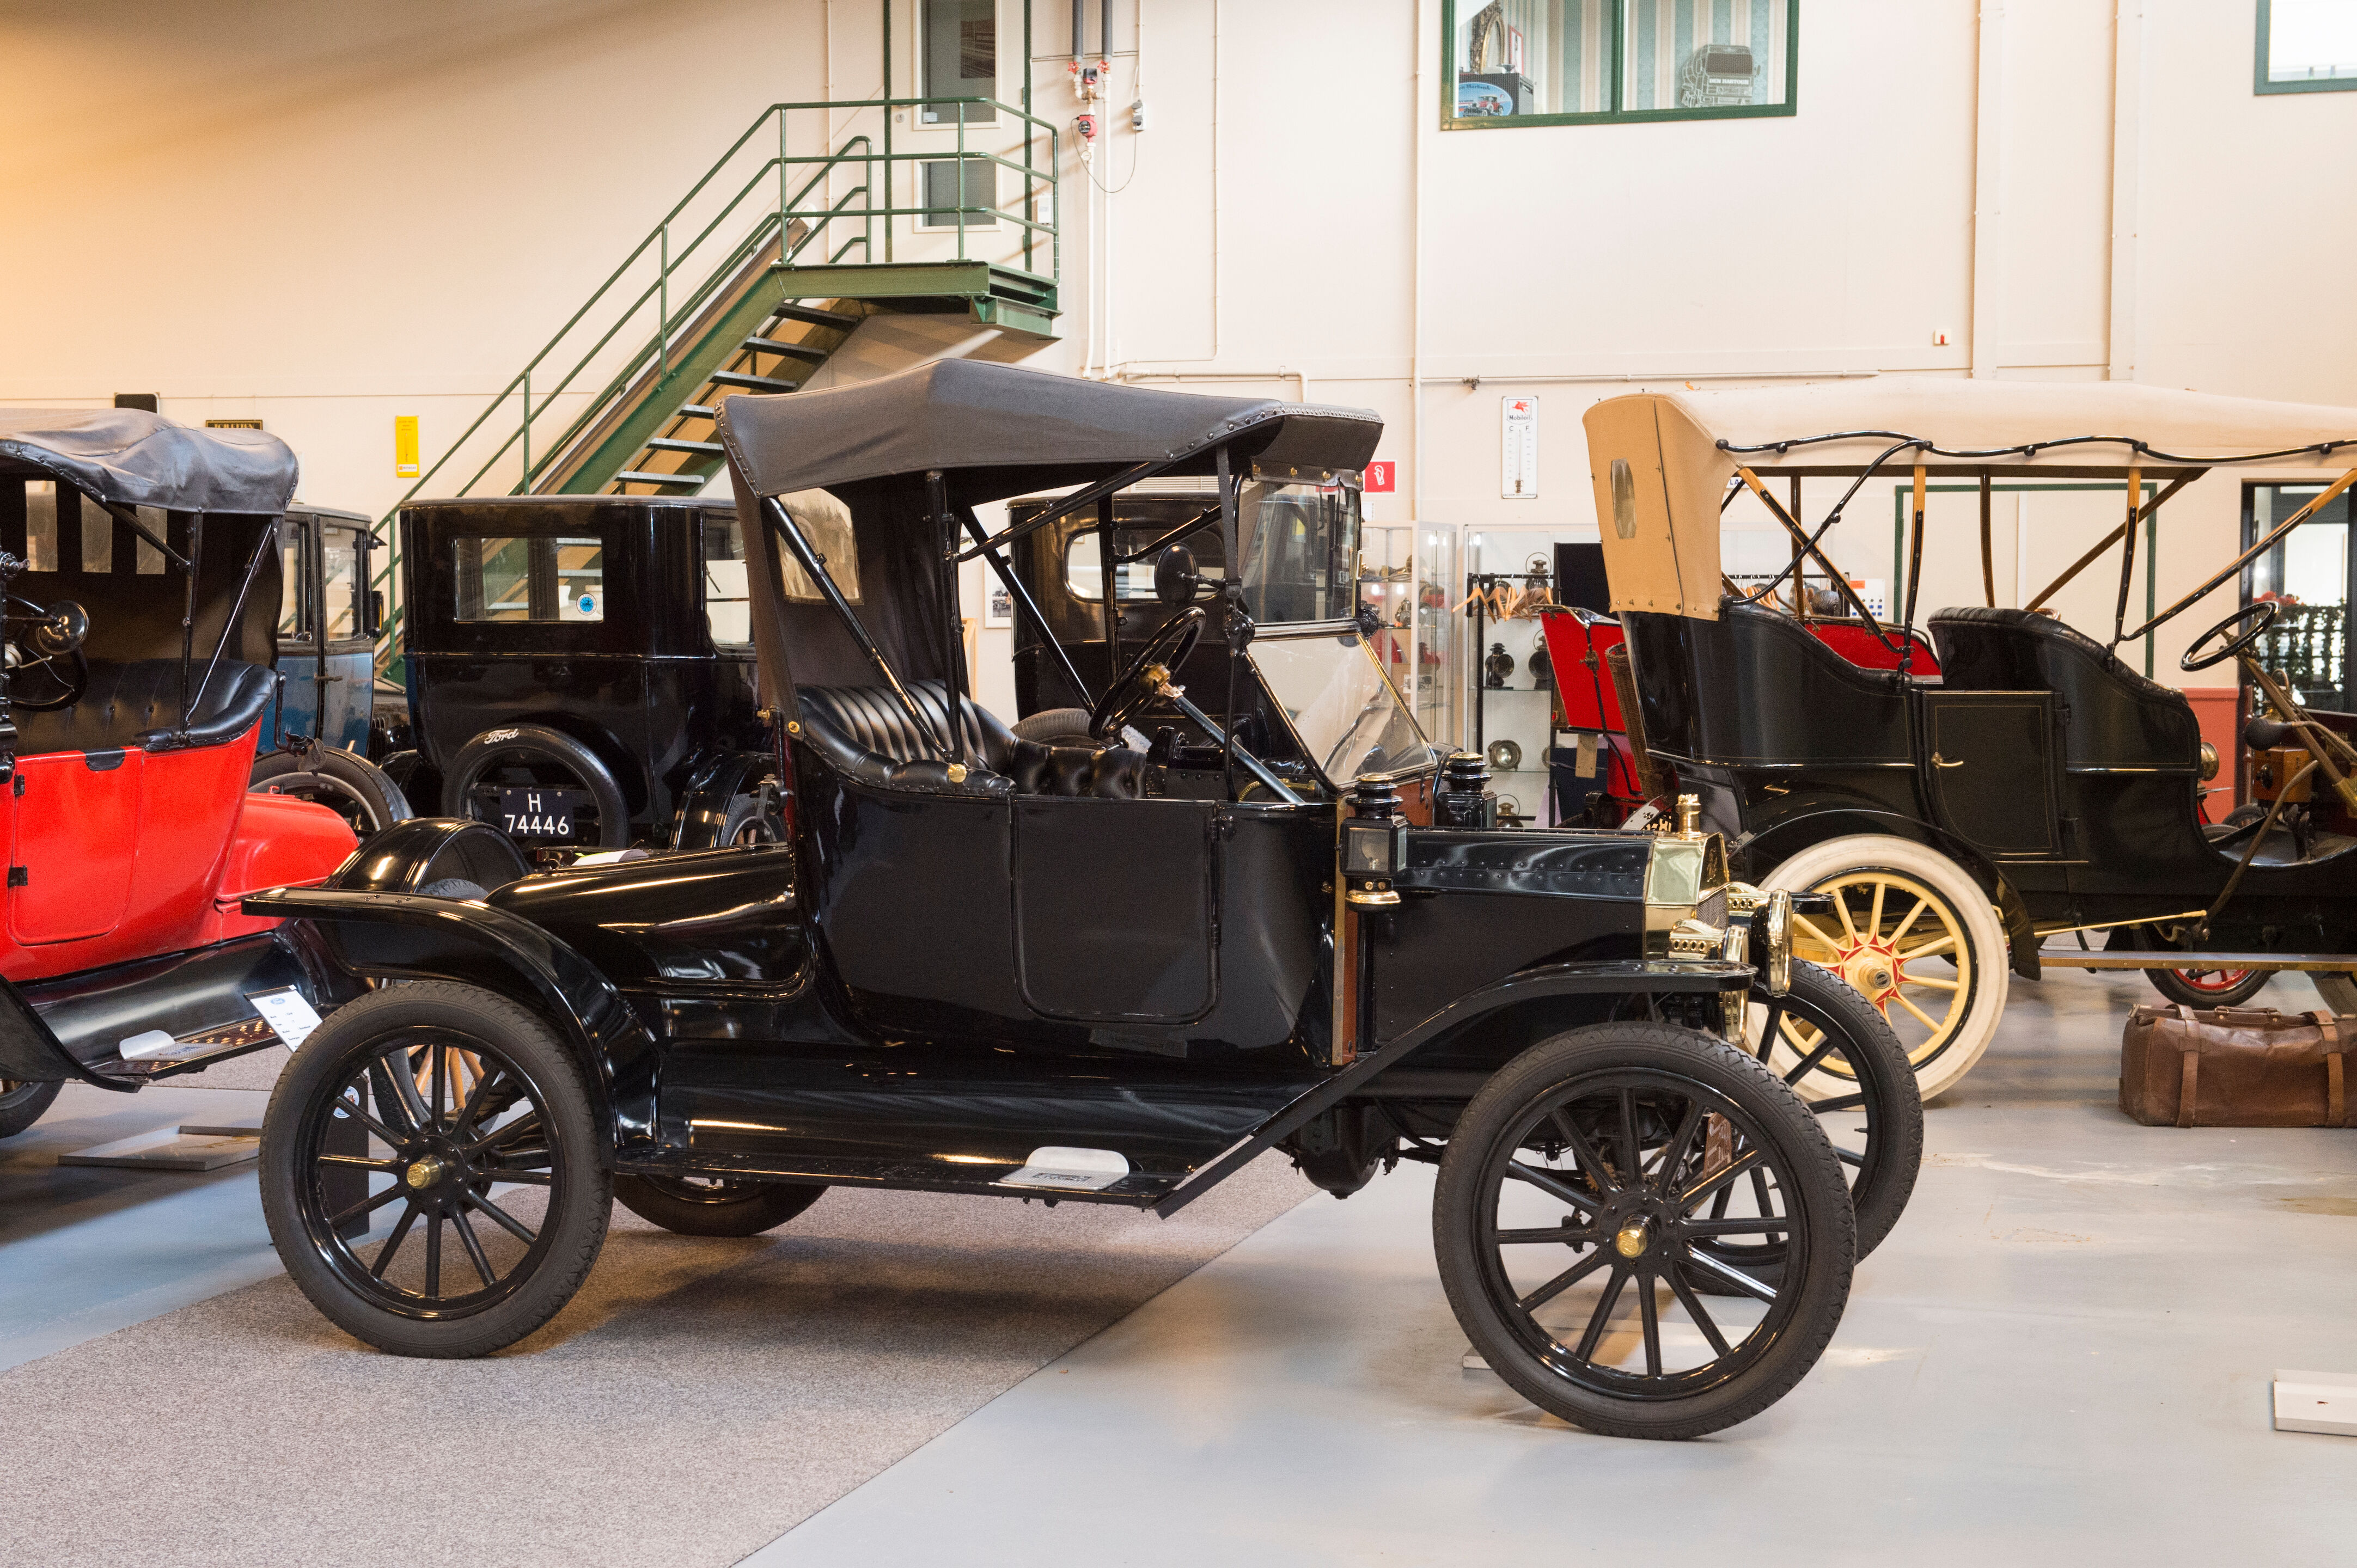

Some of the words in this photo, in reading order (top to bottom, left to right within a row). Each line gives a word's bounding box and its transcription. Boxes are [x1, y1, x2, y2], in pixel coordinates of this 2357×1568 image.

[484, 728, 519, 744] Ford
[528, 793, 541, 812] H
[504, 814, 569, 835] 74446
